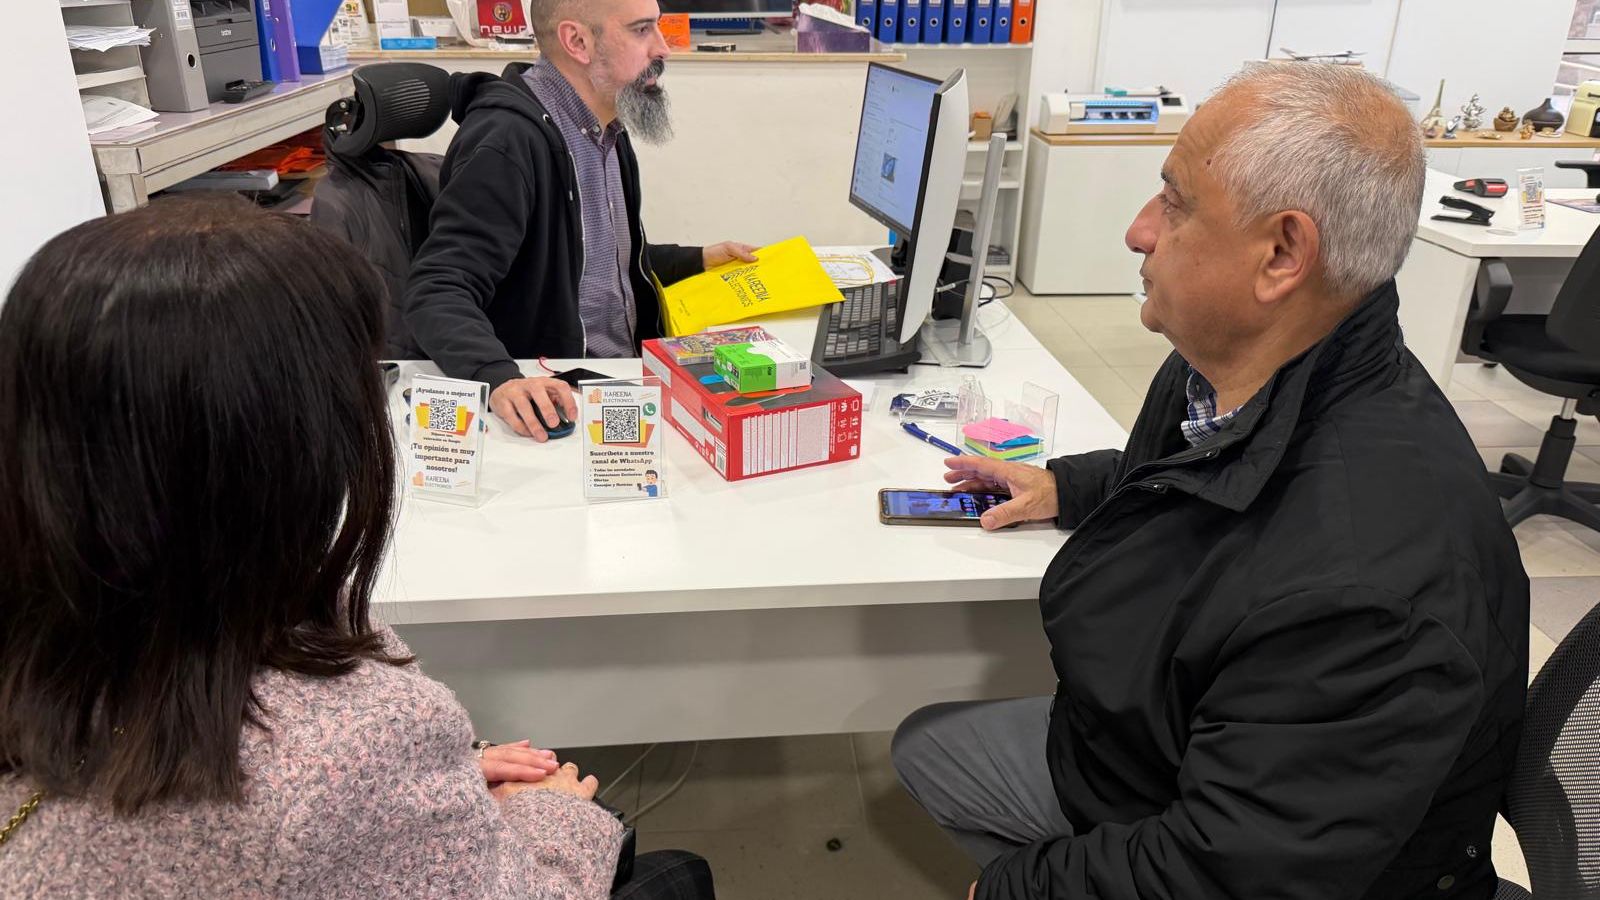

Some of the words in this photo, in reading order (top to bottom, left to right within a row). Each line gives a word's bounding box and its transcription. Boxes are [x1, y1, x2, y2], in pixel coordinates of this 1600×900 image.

[424, 445, 449, 453] opinión
[415, 453, 453, 463] importante
[426, 464, 458, 473] nosotros!
